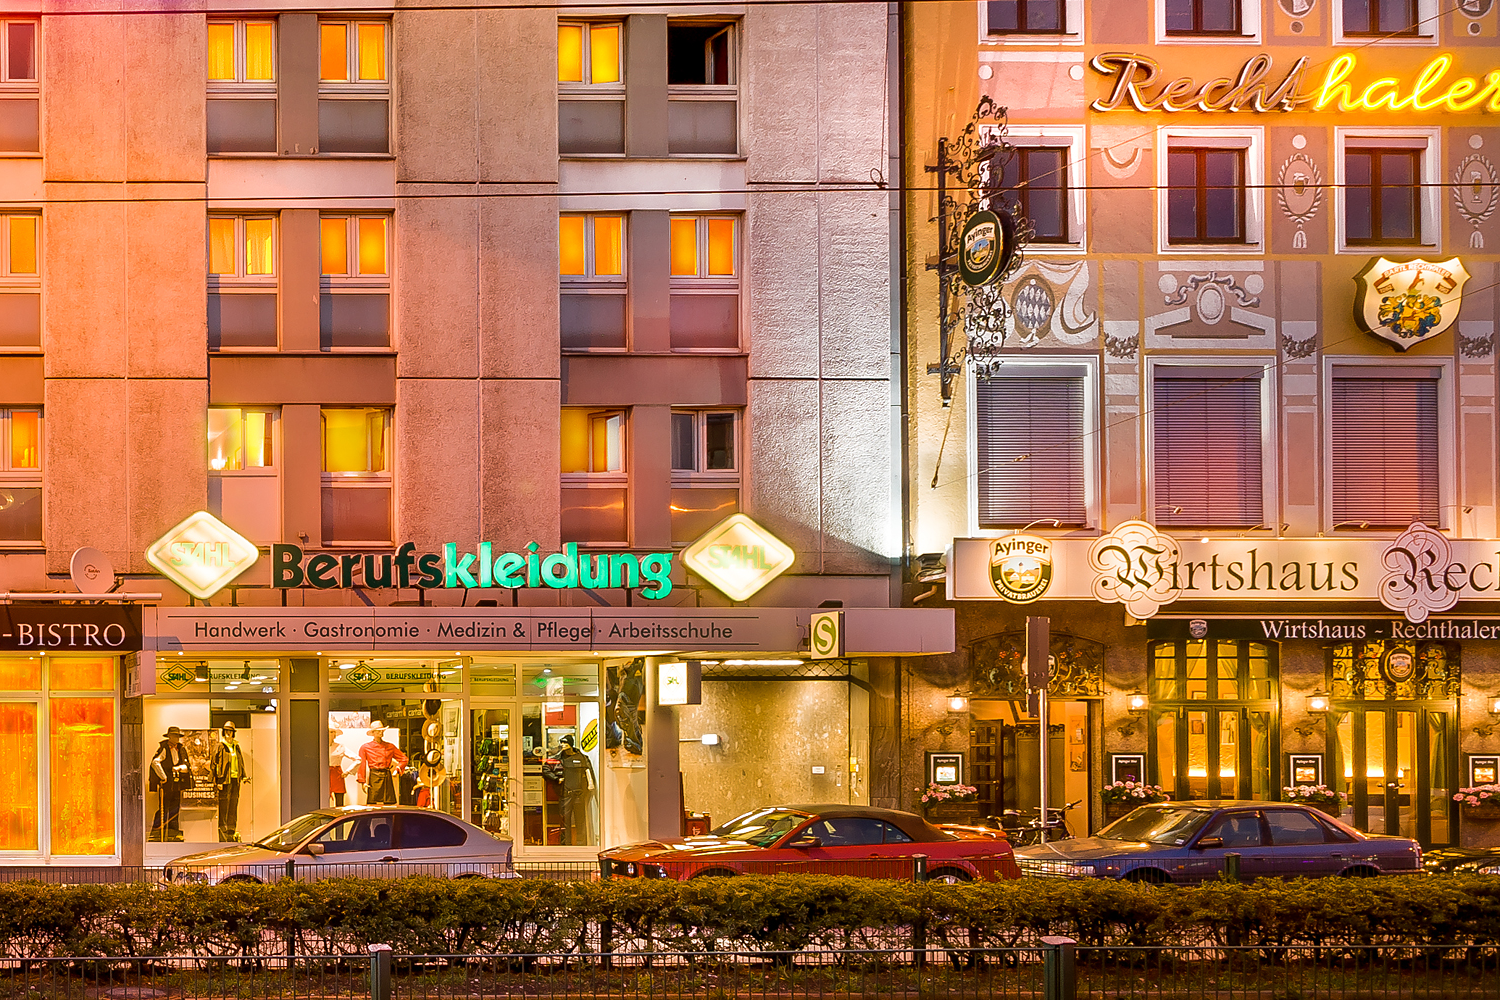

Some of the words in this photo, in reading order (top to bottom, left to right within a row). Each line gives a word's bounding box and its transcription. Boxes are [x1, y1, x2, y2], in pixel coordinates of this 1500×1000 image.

[967, 226, 993, 242] Ayinger
[170, 542, 236, 567] STAHL
[994, 537, 1049, 556] Ayinger
[707, 544, 774, 571] STAHL
[269, 541, 674, 600] Berufskleidung
[1097, 545, 1359, 593] Wirtshaus
[995, 578, 1049, 600] PRIVATBRAUEREI
[194, 622, 286, 638] Handwerk
[303, 621, 420, 638] Gastronomie
[437, 622, 507, 639] Medizin
[512, 622, 526, 639] &
[537, 622, 591, 642] Pflege
[608, 622, 733, 639] Arbeitsschuhe
[1260, 621, 1367, 639] Wirtshaus
[1390, 620, 1500, 640] Rechthaler
[167, 673, 188, 682] STAHL
[183, 791, 216, 799] BUSINESS
